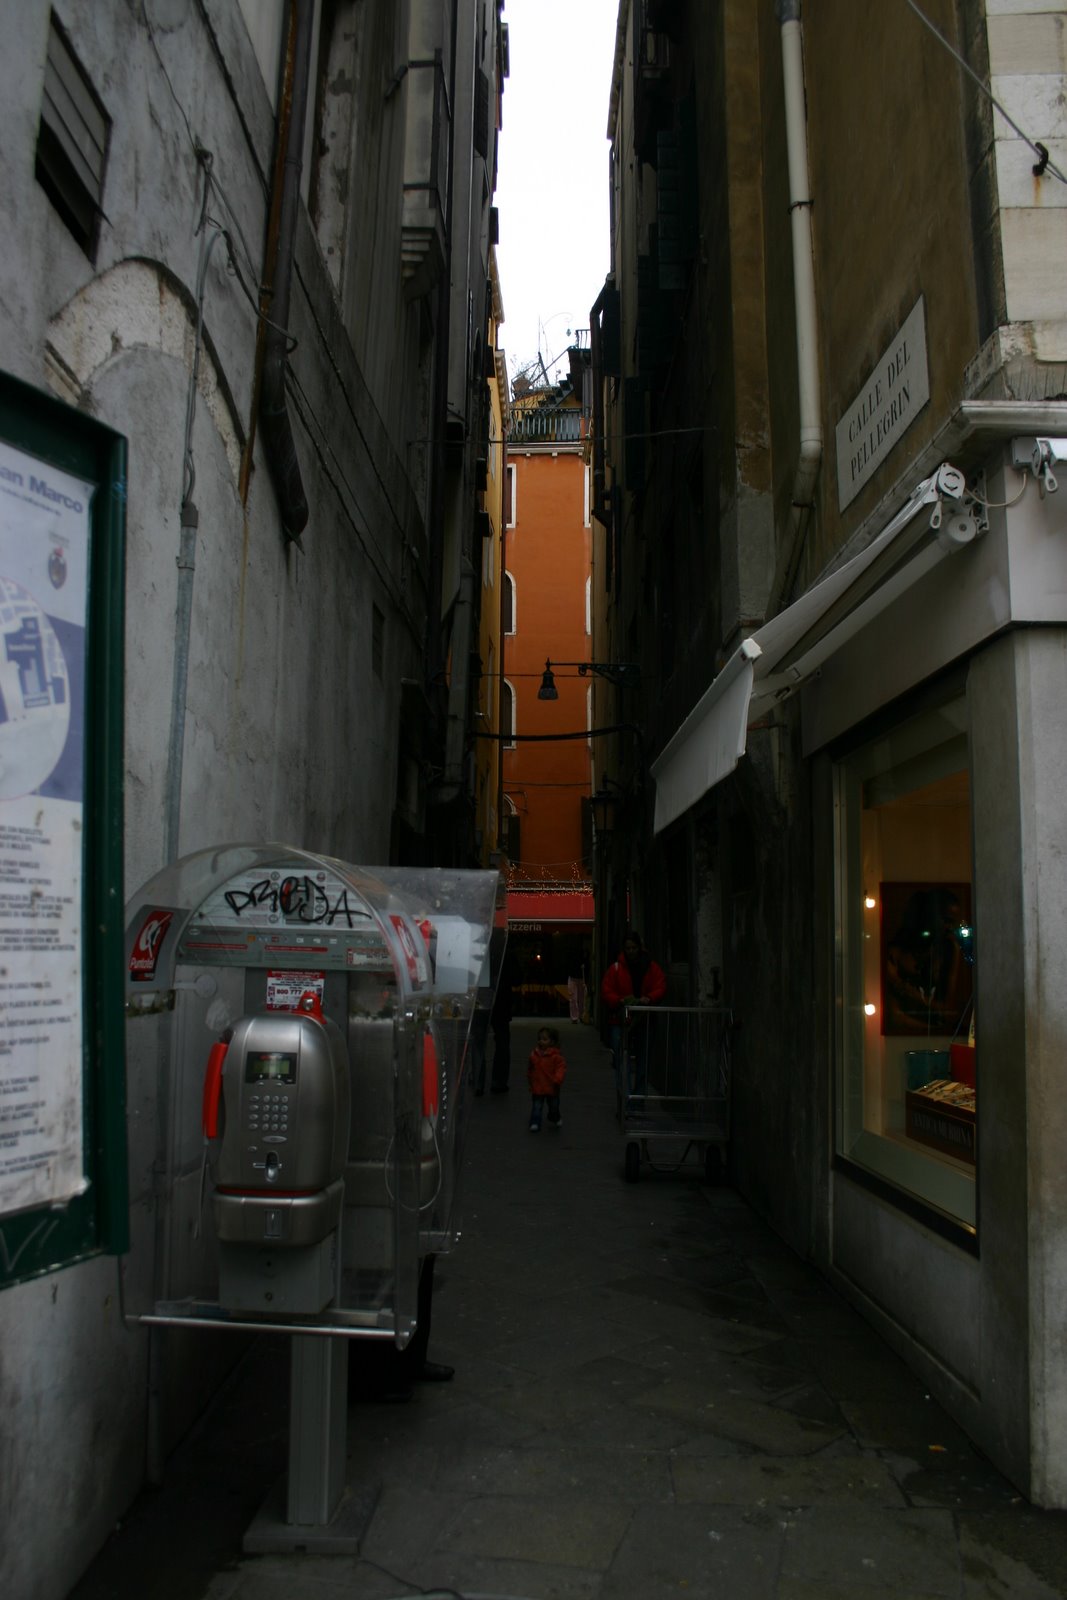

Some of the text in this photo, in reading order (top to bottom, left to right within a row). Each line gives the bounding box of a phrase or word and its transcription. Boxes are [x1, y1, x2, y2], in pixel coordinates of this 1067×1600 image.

[848, 341, 910, 442] CALLE DEL
[850, 380, 911, 481] PELLEGRIN
[0, 466, 24, 487] an
[29, 474, 83, 512] Marco
